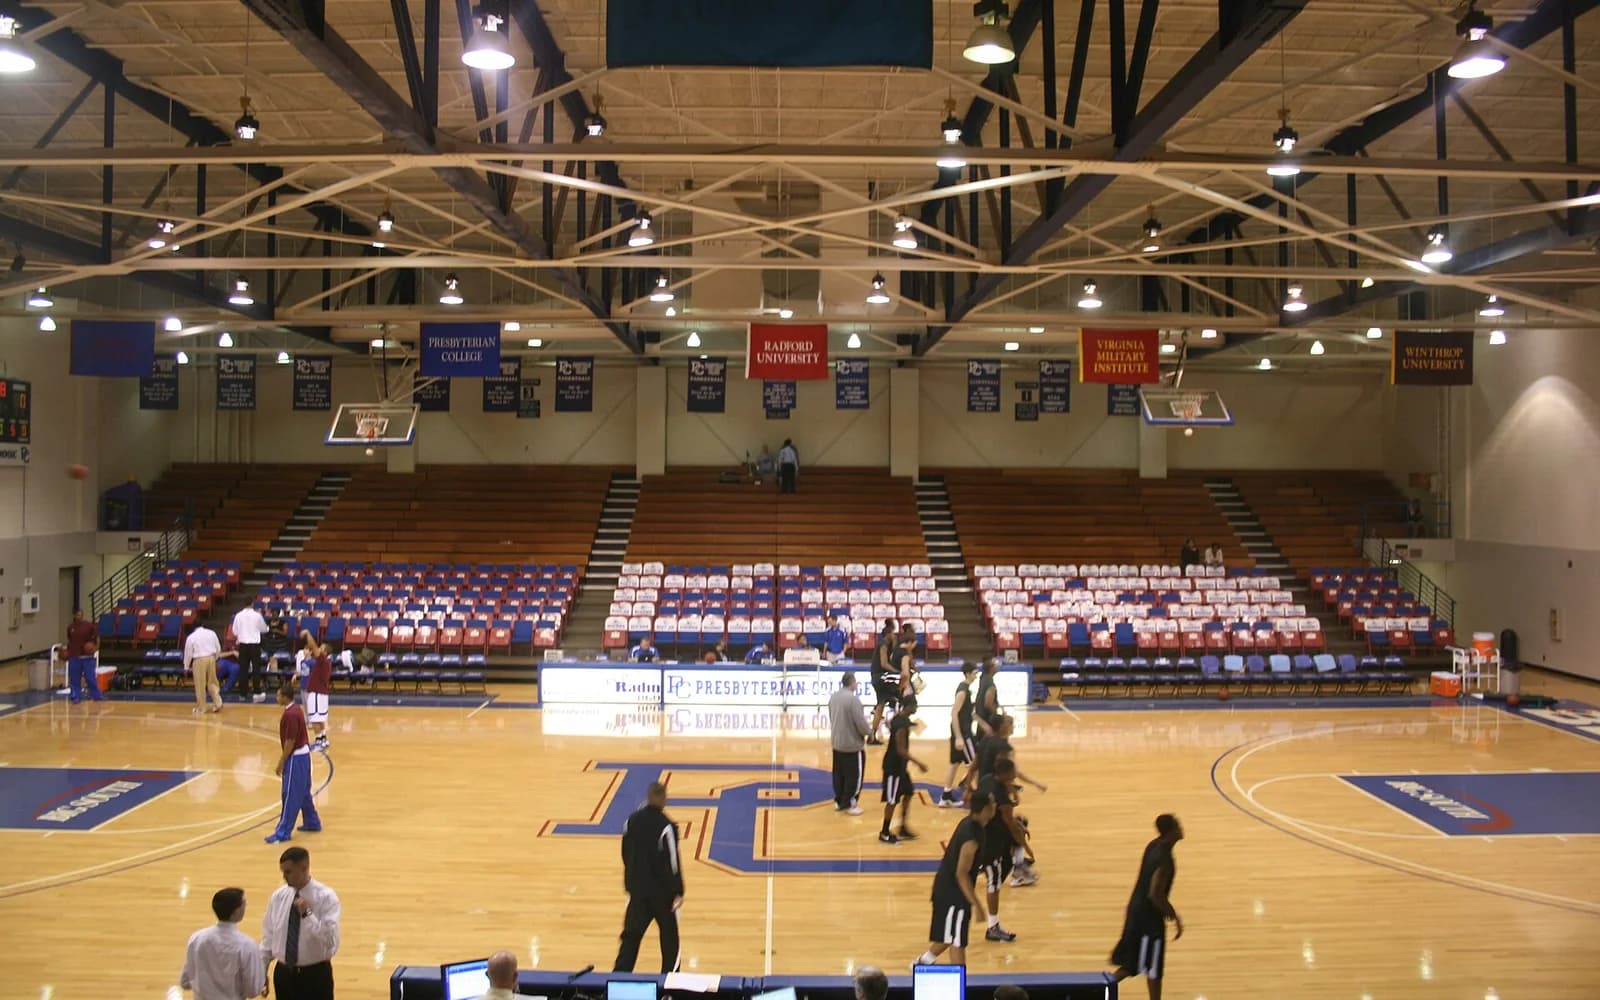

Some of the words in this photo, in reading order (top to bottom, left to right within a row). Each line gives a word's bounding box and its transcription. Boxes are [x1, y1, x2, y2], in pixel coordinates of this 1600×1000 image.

[428, 336, 496, 348] PRESBYTERIAN
[764, 340, 814, 352] RADFORD
[1097, 339, 1145, 350] VIRGINIA
[441, 351, 483, 362] COLLEGE
[1096, 351, 1146, 361] MILITARY
[1405, 346, 1463, 357] WINTHROP
[756, 352, 820, 364] UNIVERSITY
[1402, 358, 1465, 369] UNIVERSITY
[1094, 362, 1149, 373] INSTITUTE
[667, 675, 692, 699] PC
[695, 680, 806, 696] PRESBYTERIAN
